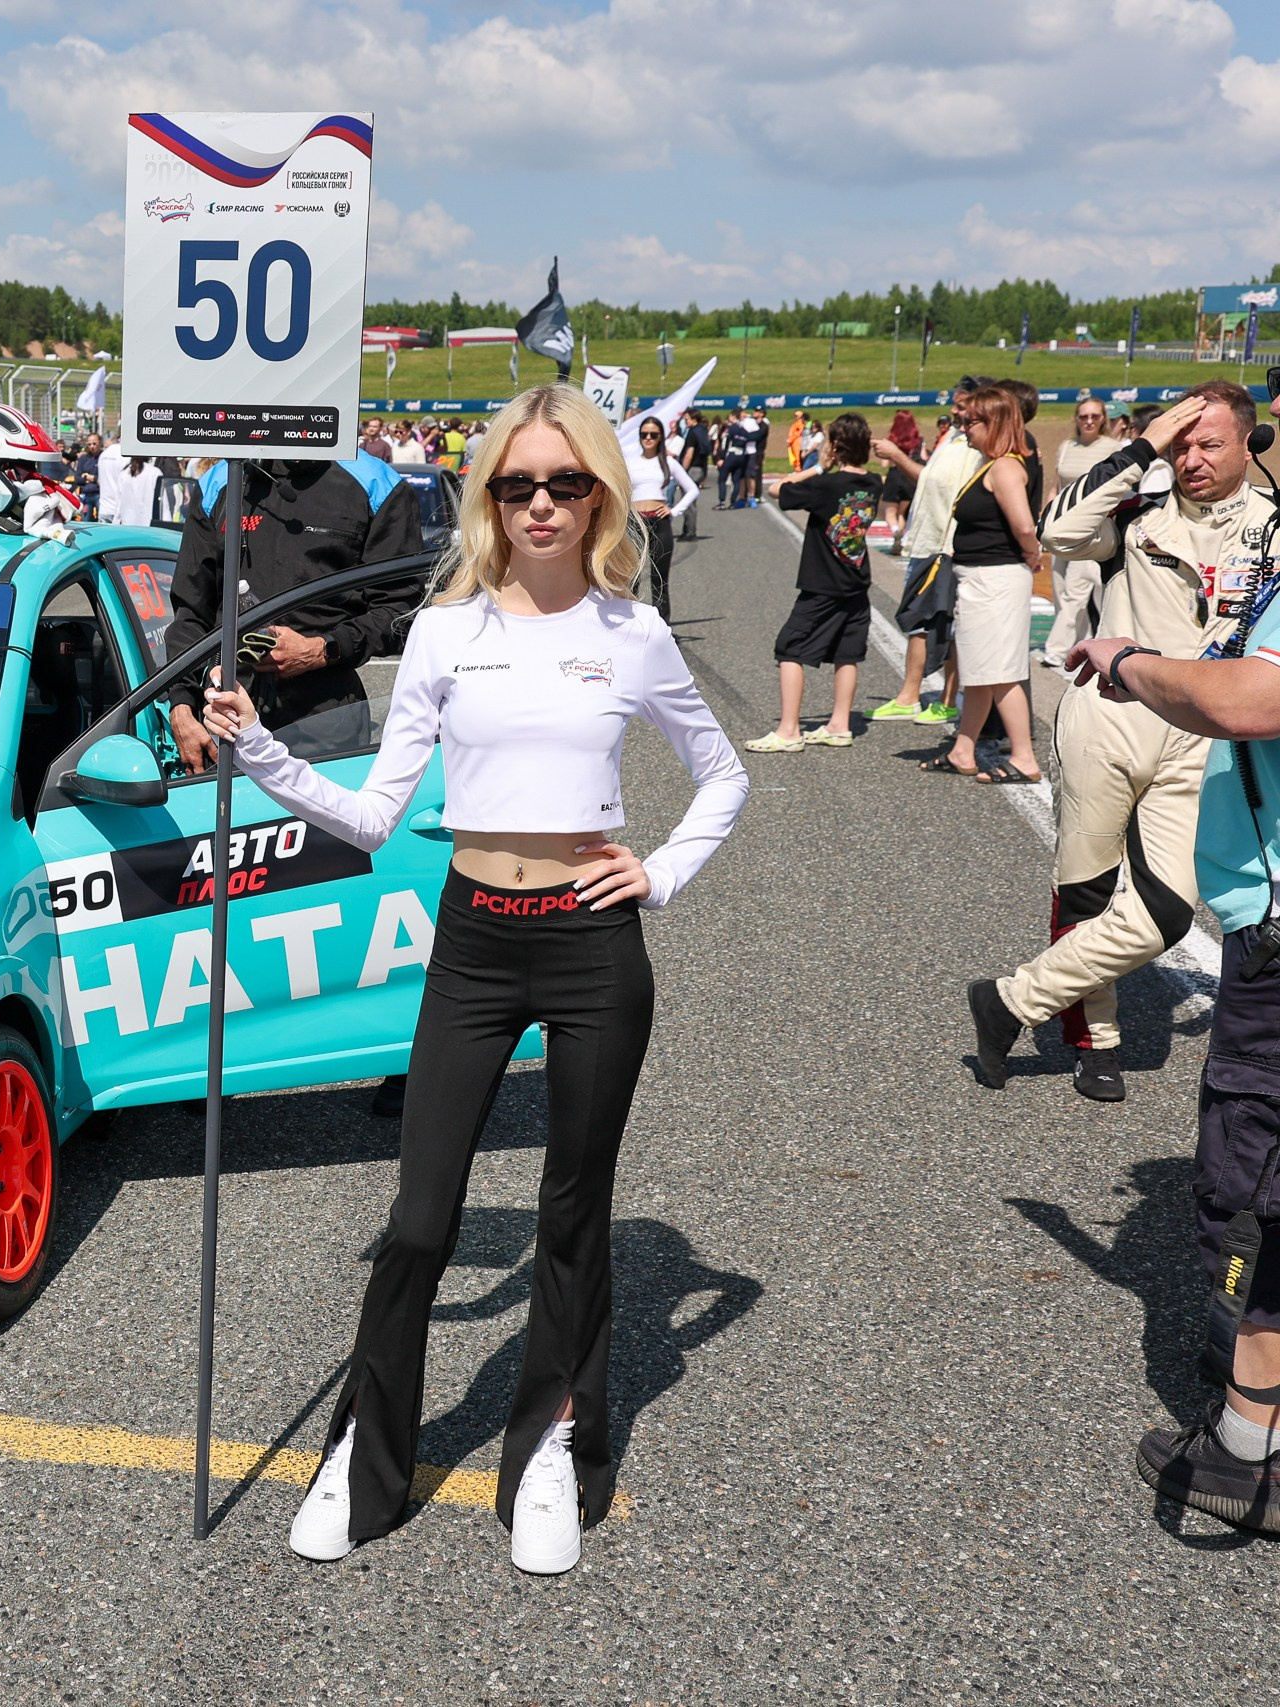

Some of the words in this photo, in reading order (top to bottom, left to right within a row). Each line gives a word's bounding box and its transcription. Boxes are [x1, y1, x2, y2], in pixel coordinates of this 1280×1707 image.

[292, 171, 329, 180] РОССИЙСКАЯ
[330, 172, 348, 180] СЕРИЯ
[291, 181, 327, 189] КОЛЬЦЕВЫХ
[328, 181, 347, 189] ГОНОК
[216, 205, 233, 213] SMP
[234, 205, 264, 213] RACING
[286, 205, 324, 213] YOKOHAMA
[175, 240, 312, 362] 50
[593, 388, 615, 411] 24
[178, 412, 210, 420] auto.ru
[237, 413, 257, 422] Видео
[310, 414, 334, 423] VOICE
[142, 426, 155, 435] MEN
[155, 427, 173, 436] TODAY
[183, 427, 236, 438] ТехИнсайдер
[121, 563, 165, 620] 50
[479, 663, 511, 671] RACING
[574, 665, 605, 674] РСКГ.РФ
[182, 820, 307, 878] АВТО
[49, 870, 114, 918] 50
[471, 890, 579, 916] РСКГ.РФ
[62, 889, 436, 1049] НАТА
[1225, 1254, 1245, 1296] Nikon
